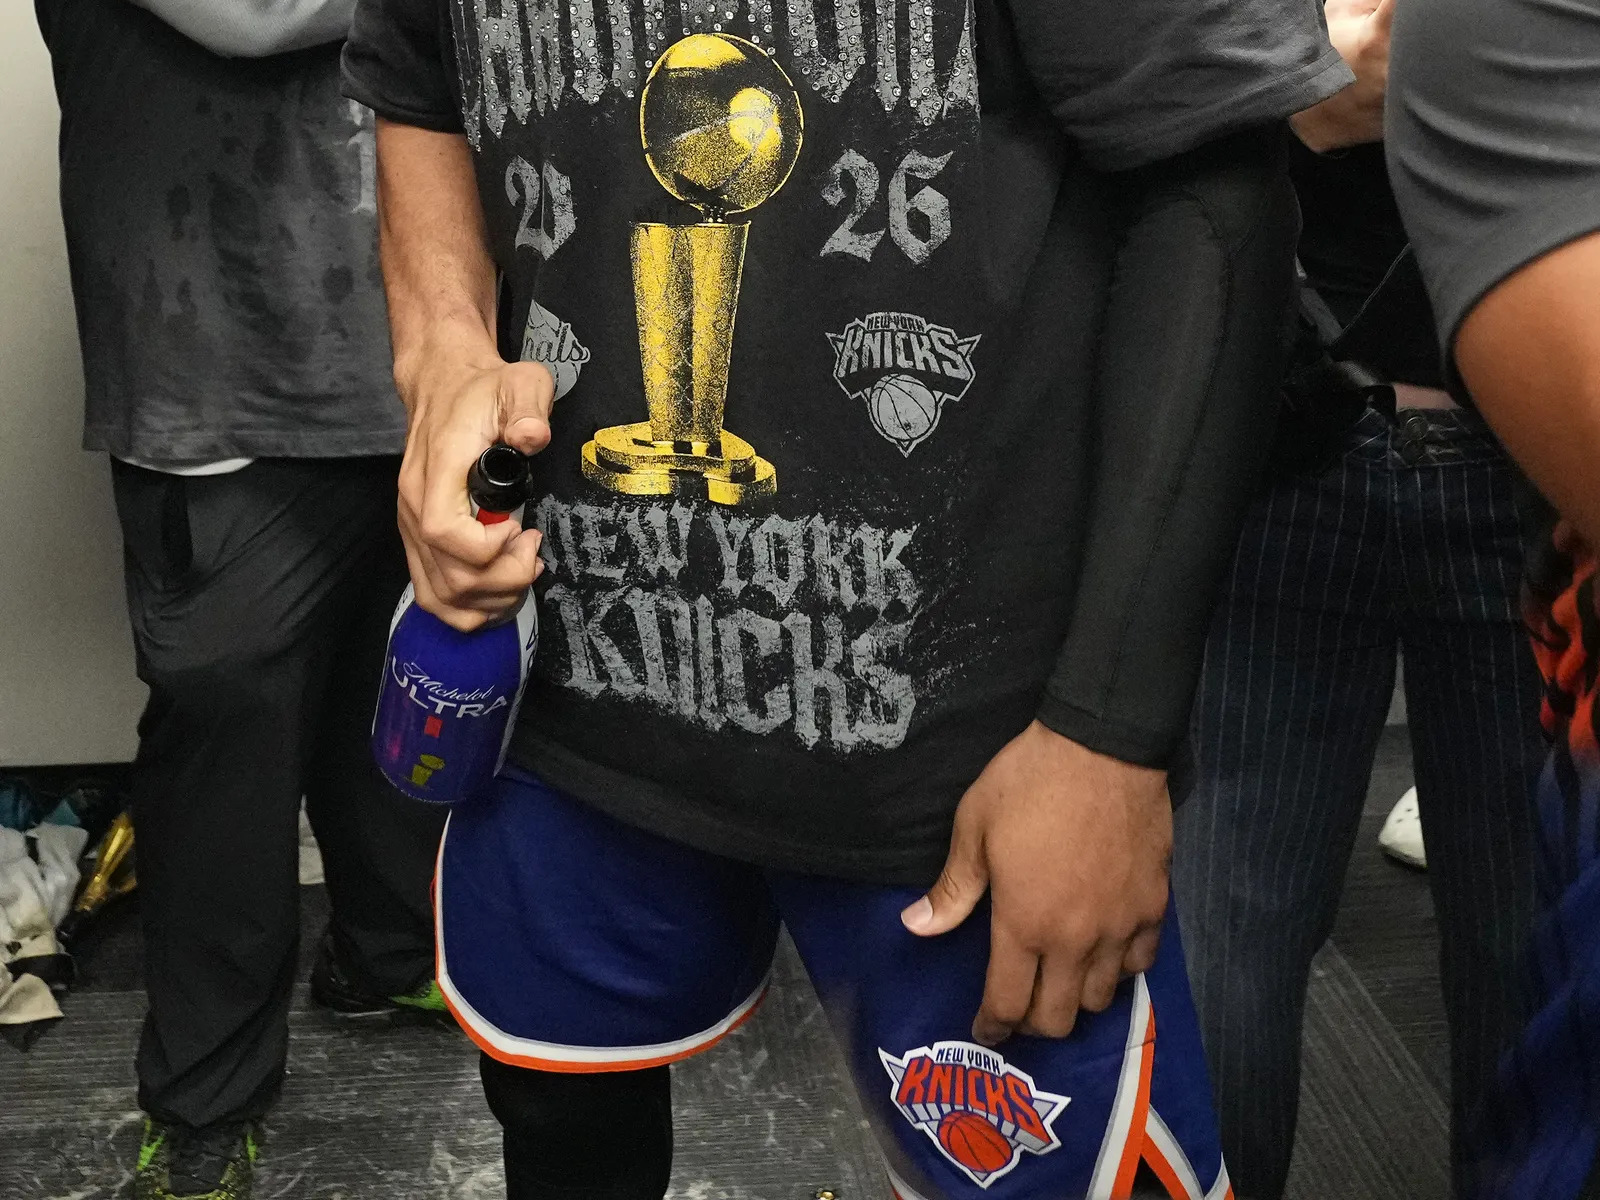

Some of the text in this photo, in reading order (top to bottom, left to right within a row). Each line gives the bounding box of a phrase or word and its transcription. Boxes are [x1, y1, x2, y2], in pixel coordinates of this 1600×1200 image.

[819, 148, 954, 265] 26
[522, 322, 590, 363] nals
[837, 326, 972, 381] KNICKS
[866, 315, 926, 333] NEW YORK
[706, 507, 922, 613] YORK
[391, 655, 508, 719] ULTRA
[402, 661, 496, 702] Michelob
[544, 583, 919, 752] KNICKS
[935, 1047, 1002, 1074] NEW YORK
[896, 1055, 1051, 1146] KNICKS
